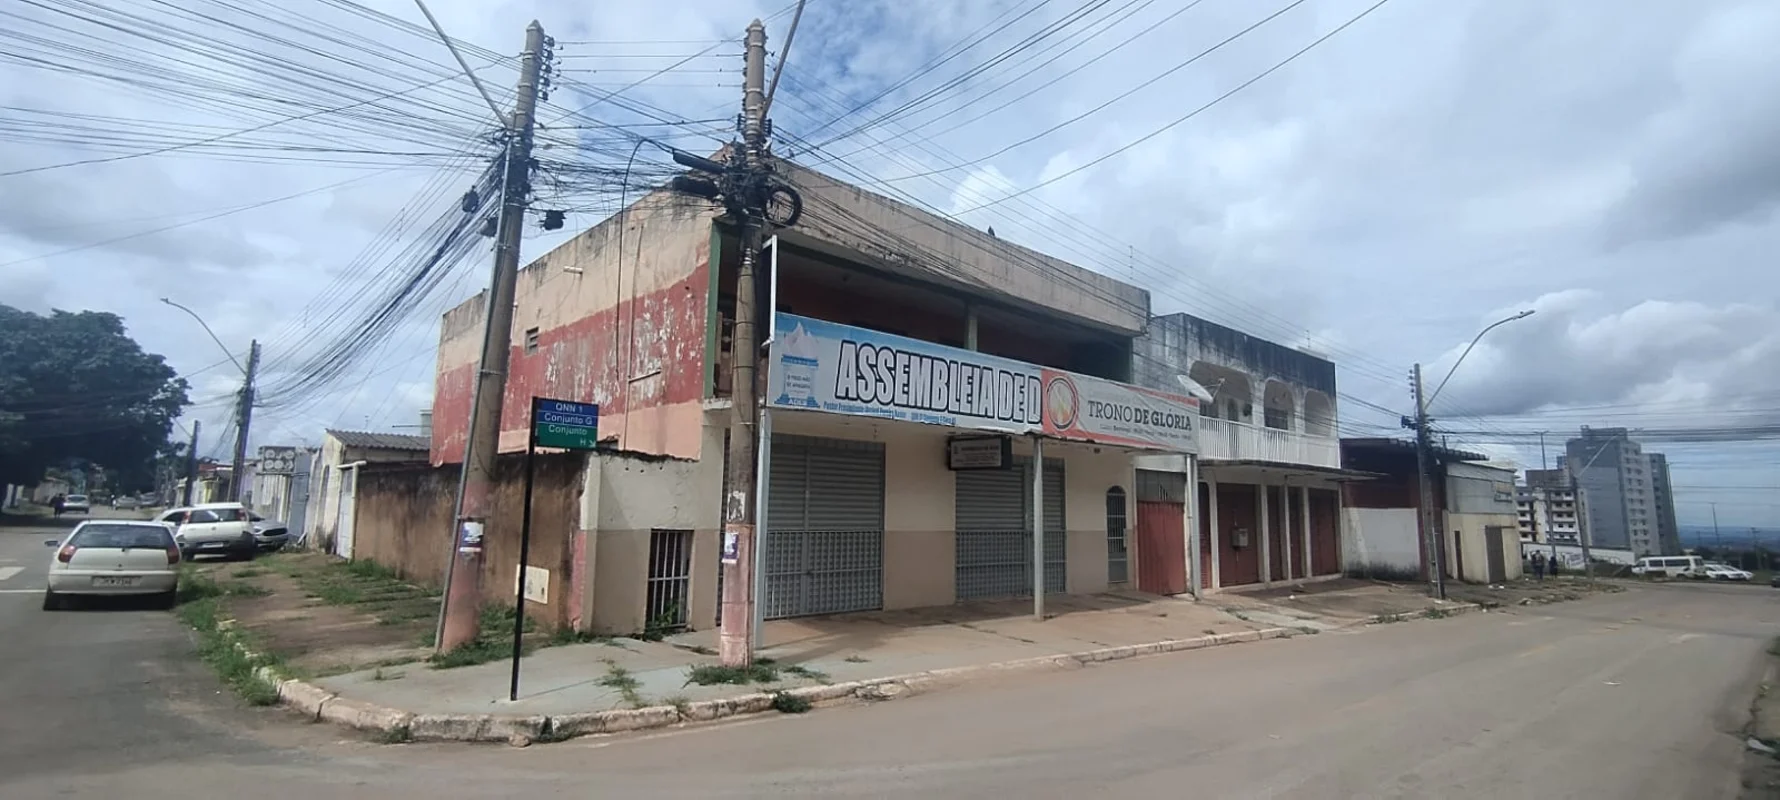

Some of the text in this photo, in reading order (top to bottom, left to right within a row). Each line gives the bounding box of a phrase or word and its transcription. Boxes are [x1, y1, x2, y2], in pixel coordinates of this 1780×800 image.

[834, 339, 995, 419] ASSEMBLEIA
[997, 370, 1025, 424] DE
[555, 403, 576, 412] QNN
[544, 413, 593, 425] Conjunto G
[1088, 400, 1132, 422] TRONO
[1134, 407, 1149, 425] DE
[1151, 408, 1192, 431] GLÓRIA
[548, 425, 588, 435] Conjunto
